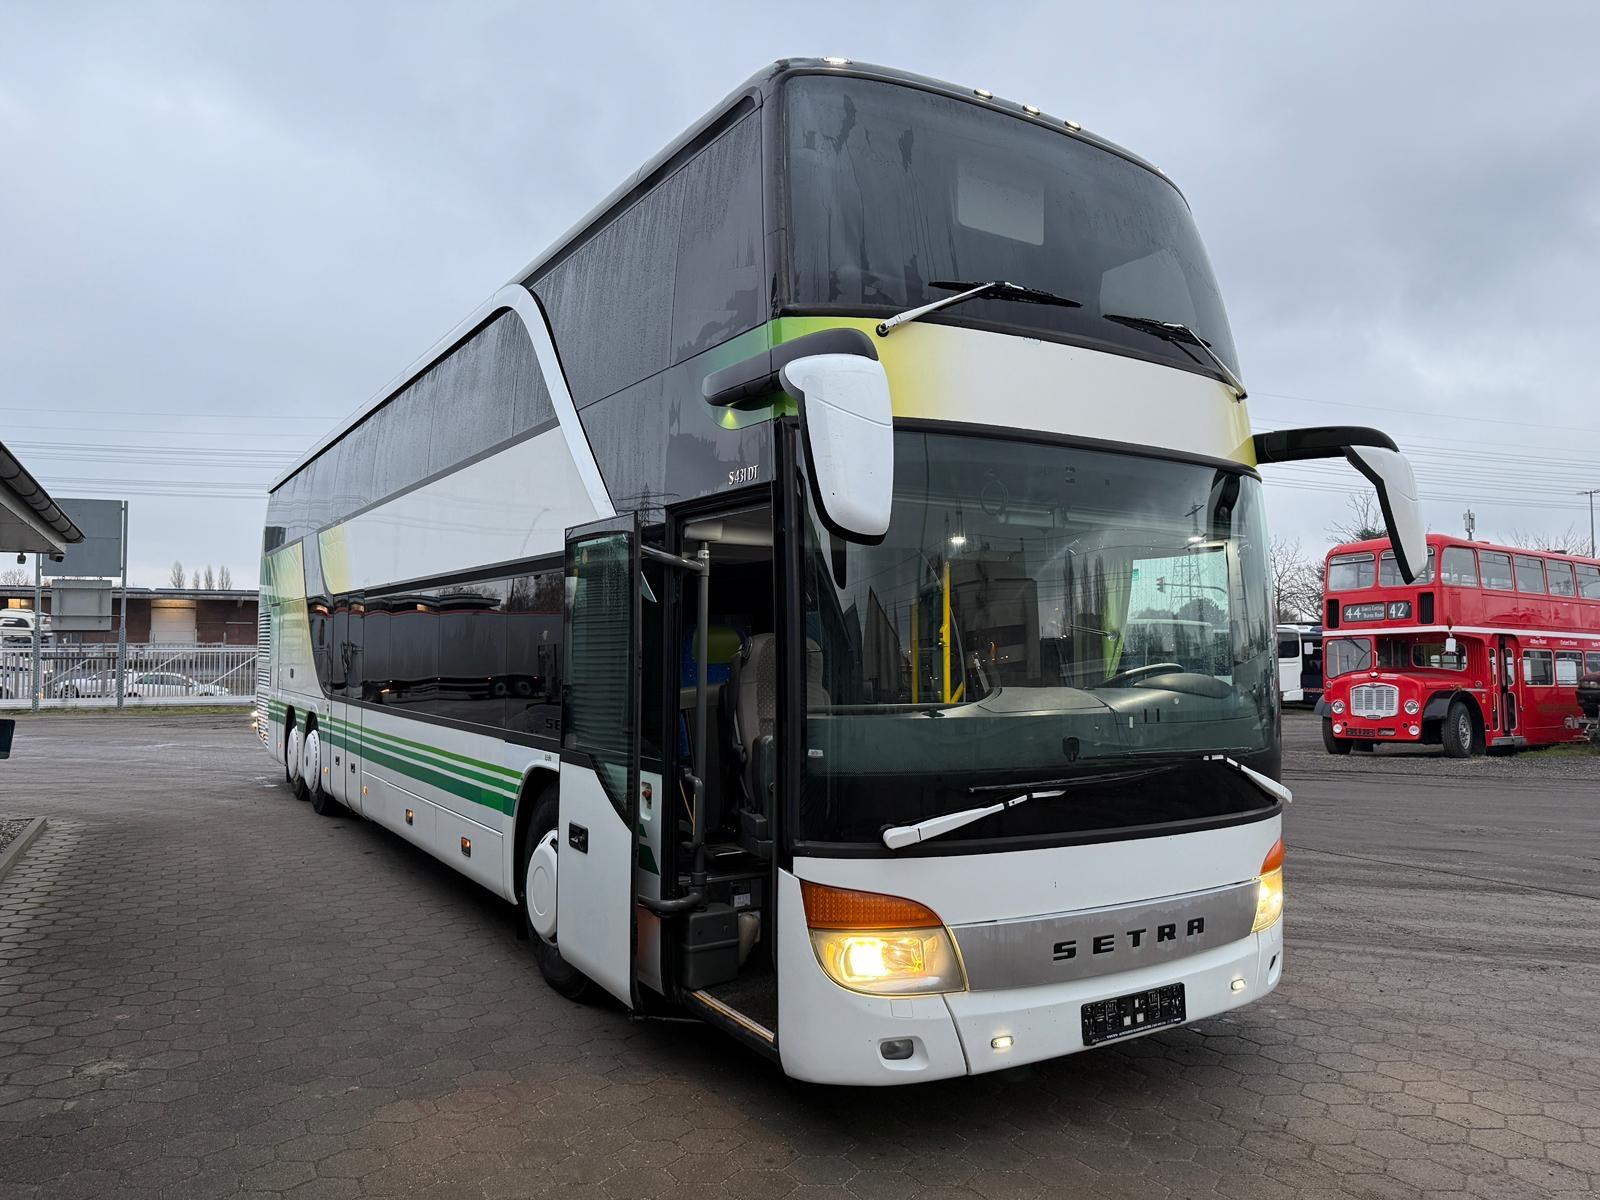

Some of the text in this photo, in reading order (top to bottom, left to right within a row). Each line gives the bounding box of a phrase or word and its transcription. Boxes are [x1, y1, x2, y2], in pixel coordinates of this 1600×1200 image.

[735, 467, 748, 484] 431
[748, 464, 760, 480] DT
[1345, 607, 1361, 619] 44
[1389, 603, 1405, 618] 42
[1053, 917, 1204, 961] SETRA
